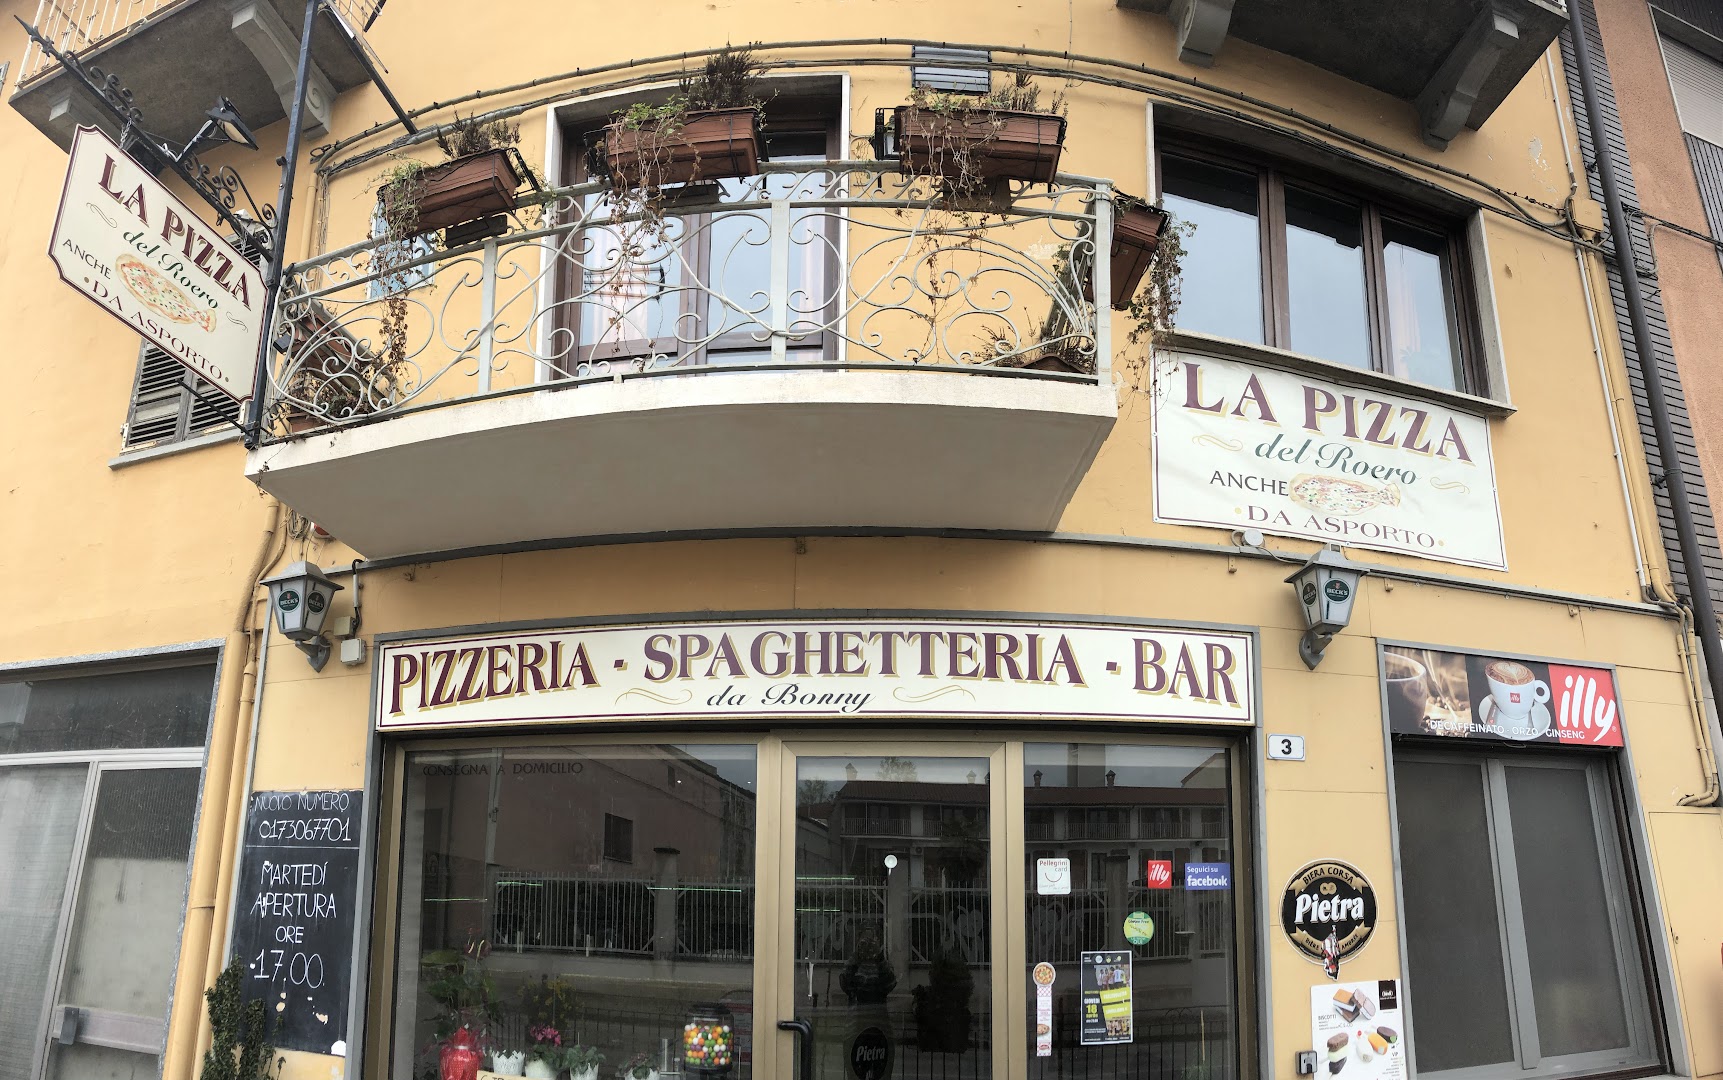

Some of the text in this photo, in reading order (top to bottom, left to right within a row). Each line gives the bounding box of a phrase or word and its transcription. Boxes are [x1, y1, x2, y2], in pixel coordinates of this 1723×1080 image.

[98, 153, 252, 312] LA PIZZA
[62, 238, 112, 280] ANCHE
[123, 229, 219, 309] del Roero
[92, 280, 223, 380] DA ASPORTO
[1182, 361, 1476, 467] LA PIZZA
[1255, 433, 1421, 486] del Roero
[1209, 470, 1290, 497] ANCHE
[1247, 505, 1436, 549] DA ASPORTO
[1327, 588, 1348, 596] BECK'S
[388, 630, 1242, 718] PIZZERIA SPAGHETTERIA BAR
[706, 682, 876, 713] da Bonny
[1559, 674, 1616, 742] illy
[1430, 719, 1585, 740] DECAFFEINATO ORZO GINSENG
[1281, 738, 1293, 756] 3
[423, 762, 584, 776] CONSEGNA A DOMICILIO
[298, 793, 350, 812] NUMERO
[259, 817, 351, 842] 0173067701
[1150, 863, 1170, 885] illy
[1187, 866, 1210, 874] Seguici
[1302, 867, 1355, 885] BIERA CORSA
[250, 892, 337, 918] APERTURA
[1294, 893, 1365, 925] Pietra
[275, 925, 305, 944] ORE
[1086, 1004, 1098, 1014] 18
[856, 1045, 886, 1062] Pietra
